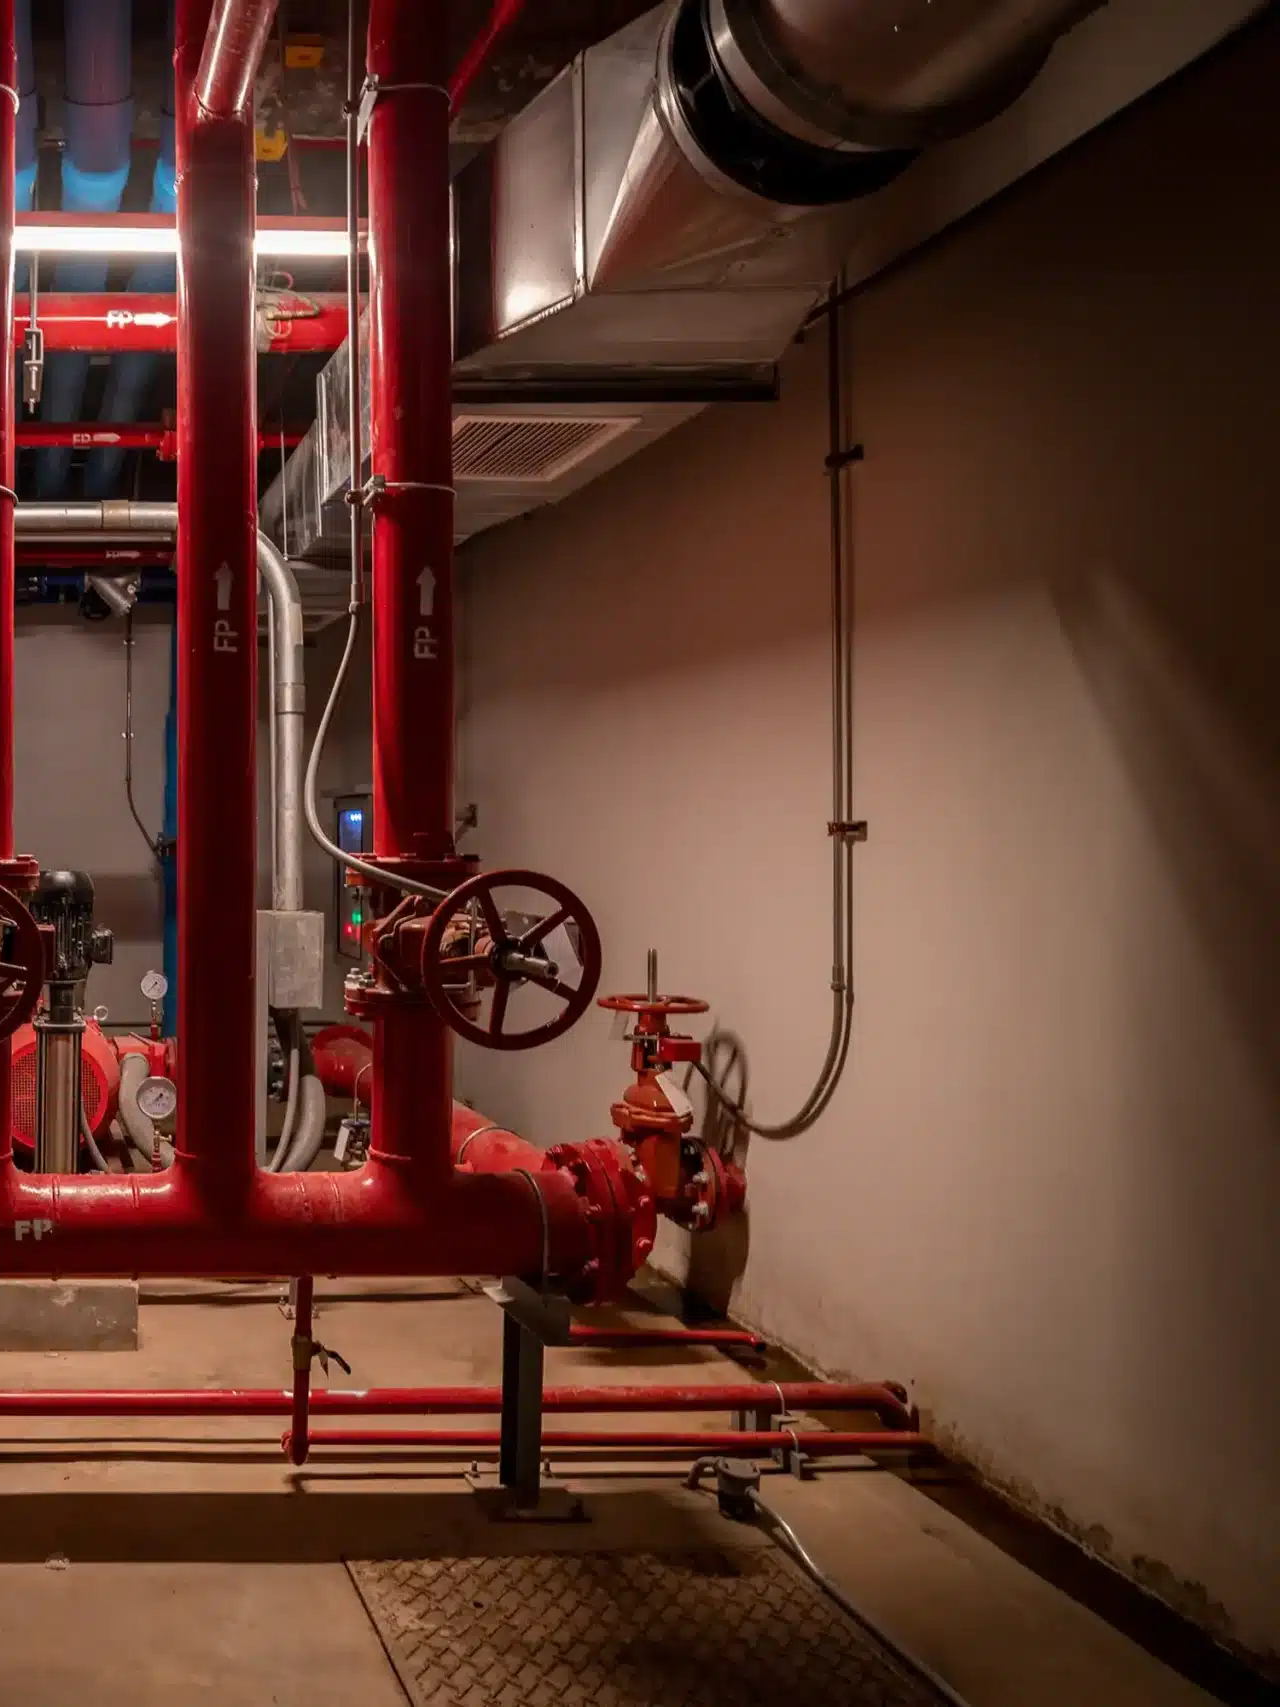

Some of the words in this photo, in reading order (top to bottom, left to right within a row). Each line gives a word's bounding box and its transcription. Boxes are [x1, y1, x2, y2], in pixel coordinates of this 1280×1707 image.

[107, 309, 132, 328] FP
[214, 620, 239, 652] FP
[414, 626, 437, 659] FP
[15, 1219, 52, 1241] FP
